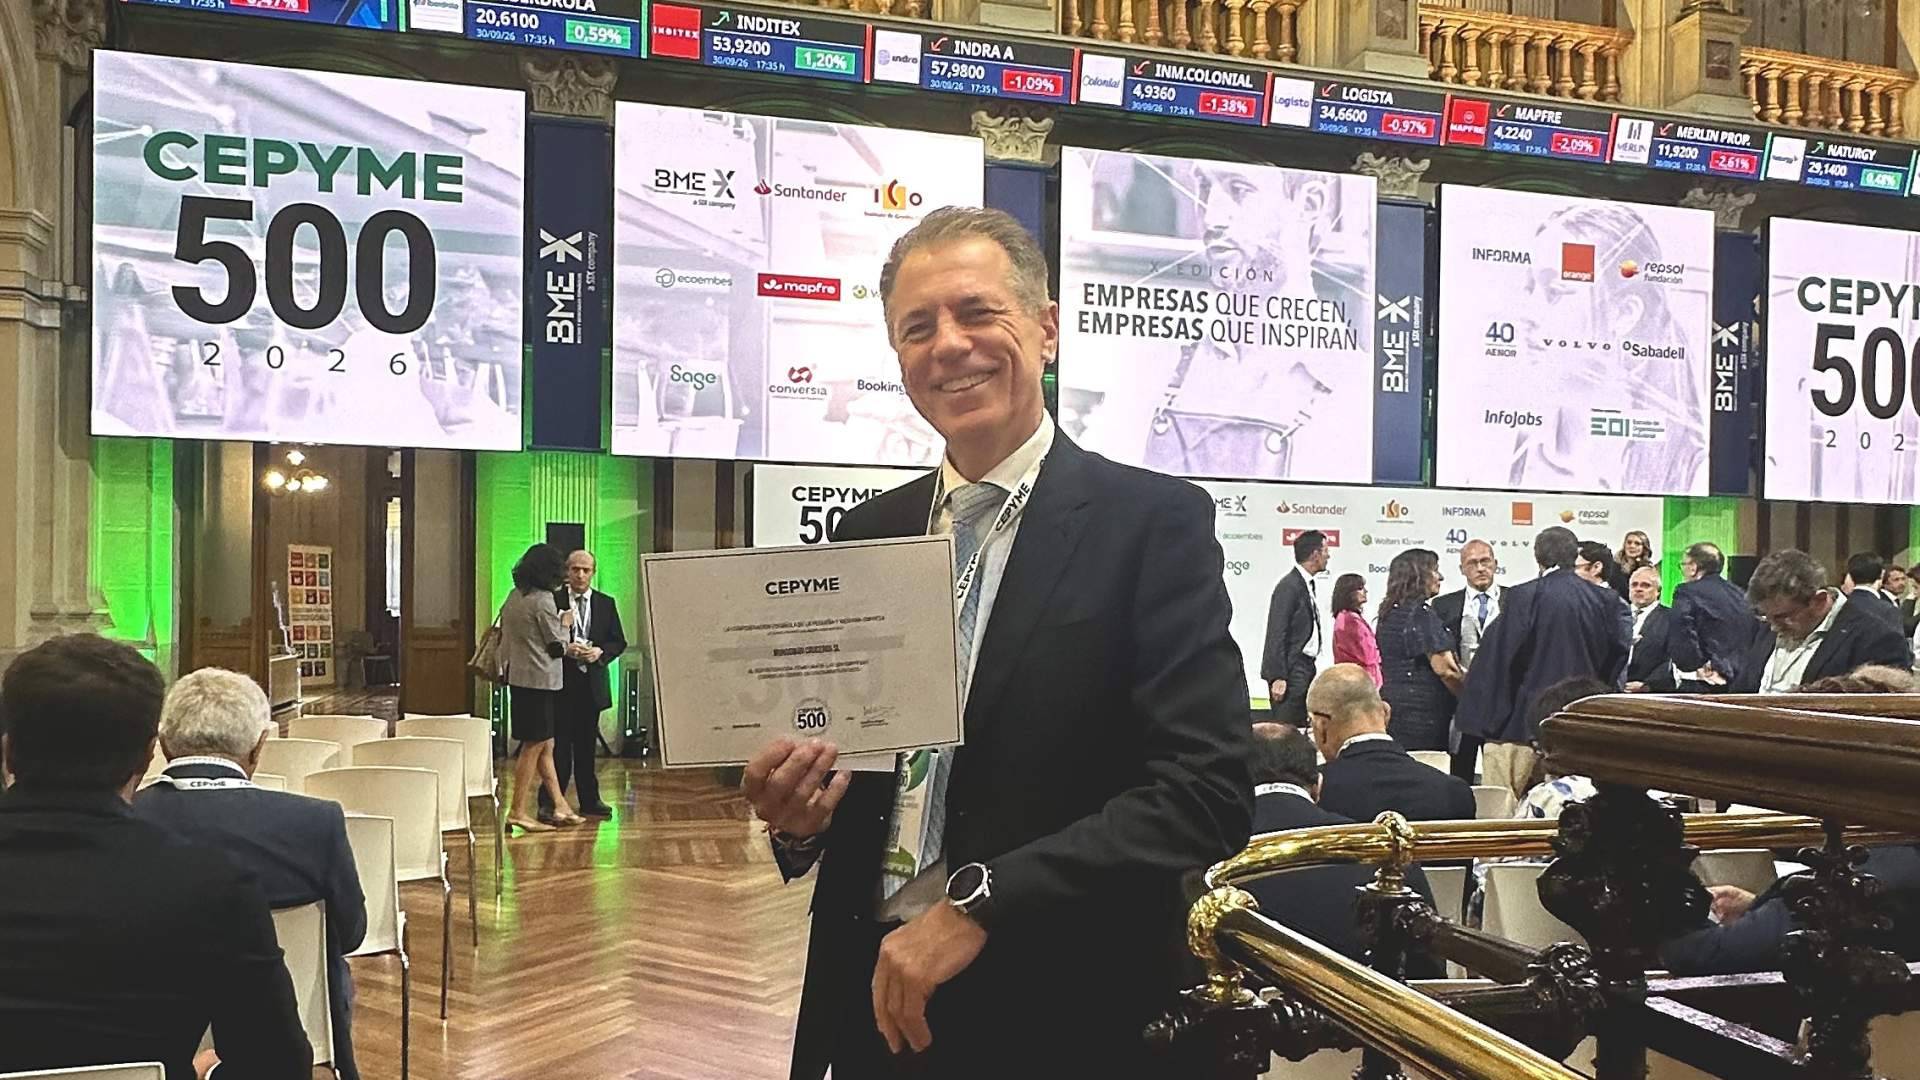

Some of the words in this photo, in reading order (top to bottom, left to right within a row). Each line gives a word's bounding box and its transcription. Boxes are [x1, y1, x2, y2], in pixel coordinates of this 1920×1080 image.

[476, 8, 539, 29] 20,6100
[737, 15, 800, 36] INDITEX
[524, 33, 547, 45] 17:35
[549, 36, 555, 46] h
[574, 27, 622, 45] 0,59%
[712, 36, 771, 56] 53,9200
[954, 40, 1001, 59] INDRA
[1002, 46, 1015, 60] A
[756, 60, 777, 71] 17:35
[804, 52, 848, 70] 1,20%
[931, 61, 985, 80] 57,9800
[1155, 63, 1253, 88] INM.COLONIAL
[1009, 75, 1055, 92] -1,09%
[1133, 83, 1176, 101] 4,9360
[1342, 86, 1394, 105] LOGISTA
[1205, 98, 1248, 114] -1,38%
[1320, 105, 1367, 123] 34,6600
[1515, 107, 1562, 124] MAPFRE
[1388, 118, 1427, 135] -0,97%
[1493, 125, 1532, 141] 4,2240
[1557, 137, 1594, 153] -2,09%
[1676, 125, 1720, 144] MERLIN
[1720, 131, 1751, 147] PROP.
[1657, 143, 1699, 159] 11,9200
[1827, 144, 1877, 161] NATURGY
[143, 130, 464, 203] CEPYME
[1715, 154, 1750, 169] -2,61%
[774, 183, 847, 202] Santander
[171, 194, 437, 335] 500
[1472, 247, 1532, 264] INFORMA
[1177, 261, 1274, 282] EDICIÓN
[1563, 270, 1592, 281] orange
[1644, 262, 1685, 275] repsol
[677, 275, 733, 287] ecoembes
[784, 282, 836, 296] mapfre
[1083, 283, 1209, 314] EMPRESAS
[1215, 292, 1260, 317] QUE
[1266, 296, 1353, 328] CRECEN,
[1078, 311, 1204, 341] EMPRESAS
[1210, 319, 1255, 345] QUE
[1261, 322, 1358, 351] INSPIRAN
[1485, 321, 1515, 344] 40
[1543, 338, 1611, 351] VOLVO
[670, 364, 716, 391] Sage
[1810, 322, 1920, 420] 50
[769, 384, 827, 396] conversia
[1484, 409, 1543, 428] InfoJobs
[995, 482, 1031, 532] CEPYME
[1292, 503, 1347, 516] Santander
[1578, 509, 1610, 519] repsol
[1445, 528, 1467, 544] 40
[1226, 561, 1250, 576] age
[765, 577, 840, 596] CEPYME
[797, 711, 827, 730] 500
